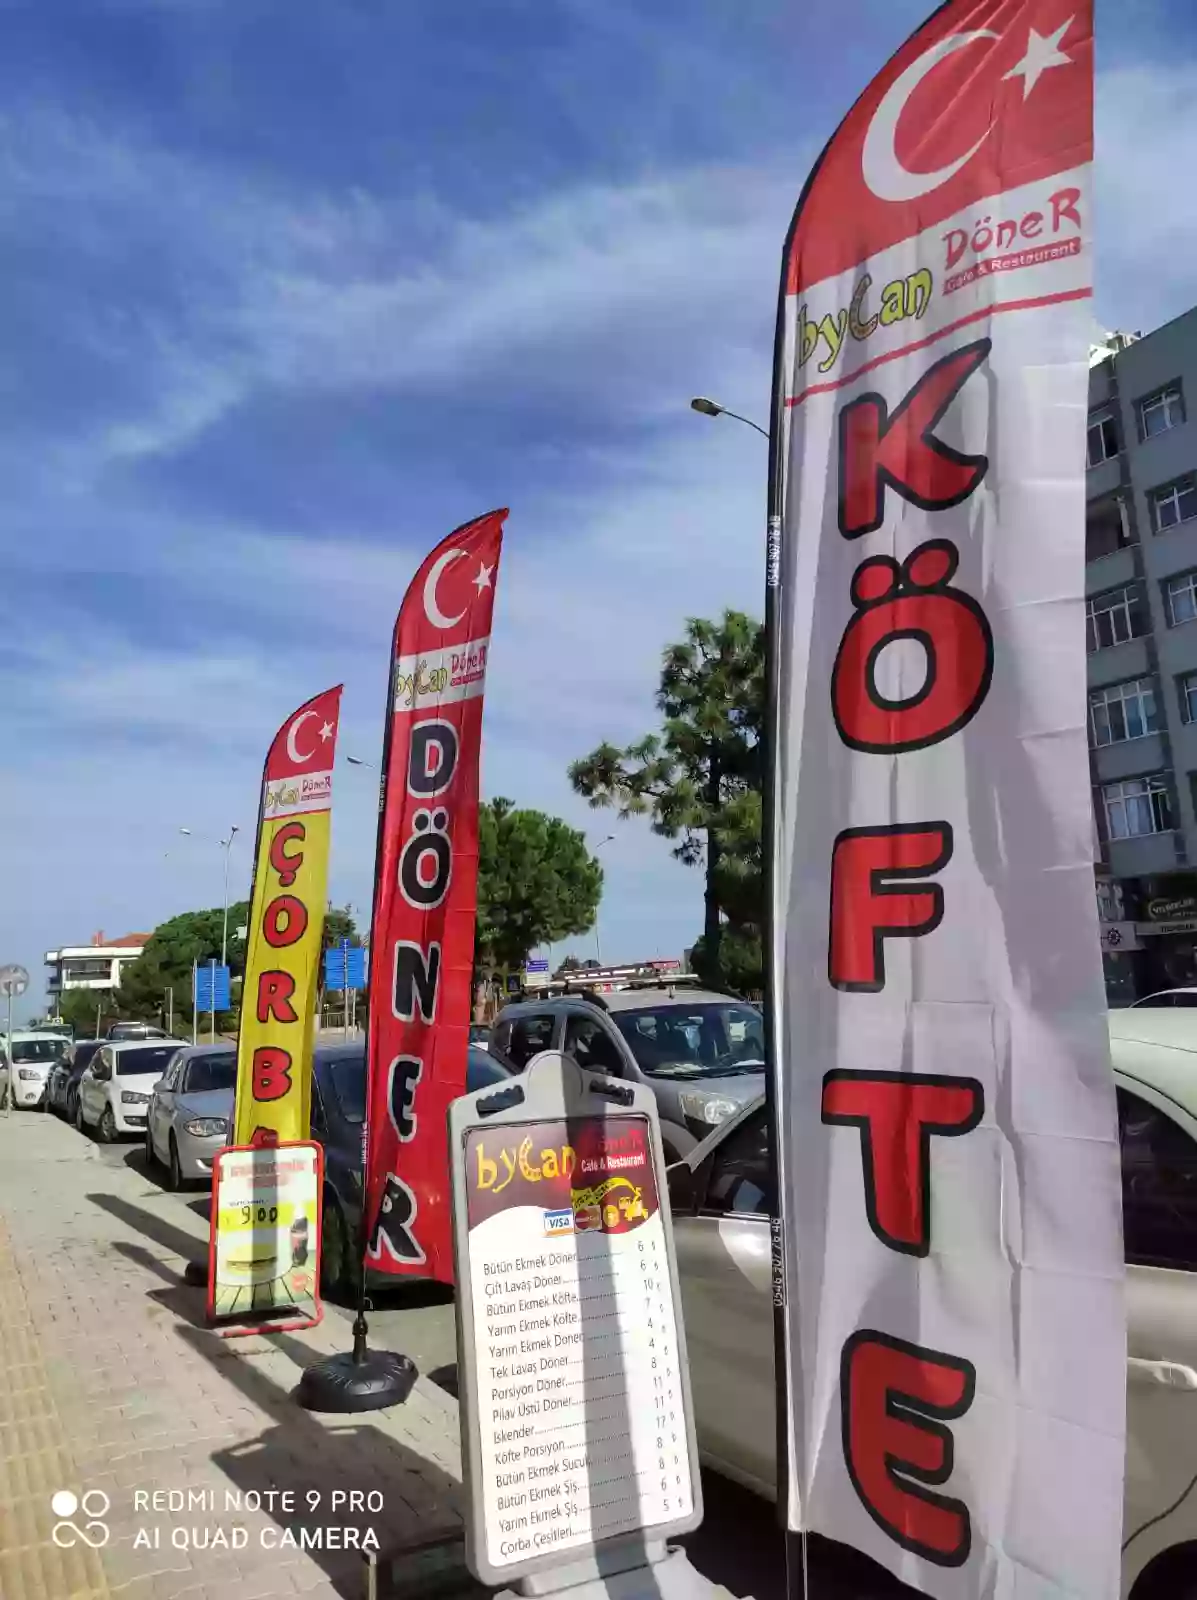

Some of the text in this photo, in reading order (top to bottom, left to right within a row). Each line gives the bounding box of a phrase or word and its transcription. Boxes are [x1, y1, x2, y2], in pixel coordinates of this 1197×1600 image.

[991, 241, 1077, 271] Restaurant
[799, 268, 933, 373] byCan
[822, 336, 993, 1567] KÖFTE
[368, 718, 459, 1265] DÖNER
[475, 1134, 577, 1193] byCan
[549, 1217, 570, 1229] VISA
[483, 1260, 513, 1276] Bütün
[515, 1256, 546, 1271] Ekmek
[485, 1283, 502, 1298] Çift
[519, 1295, 550, 1311] Ekmek
[519, 1316, 550, 1332] Ekmek
[520, 1336, 551, 1353] Ekmek
[489, 1366, 508, 1380] Tek
[491, 1384, 534, 1401] Porsiyon
[492, 1406, 516, 1422] Pilav
[523, 1440, 565, 1459] Porsiyon
[528, 1460, 560, 1480] Ekmek
[529, 1483, 561, 1502] Ekmek
[530, 1503, 562, 1524] Ekmek
[500, 1538, 531, 1559] Çorba
